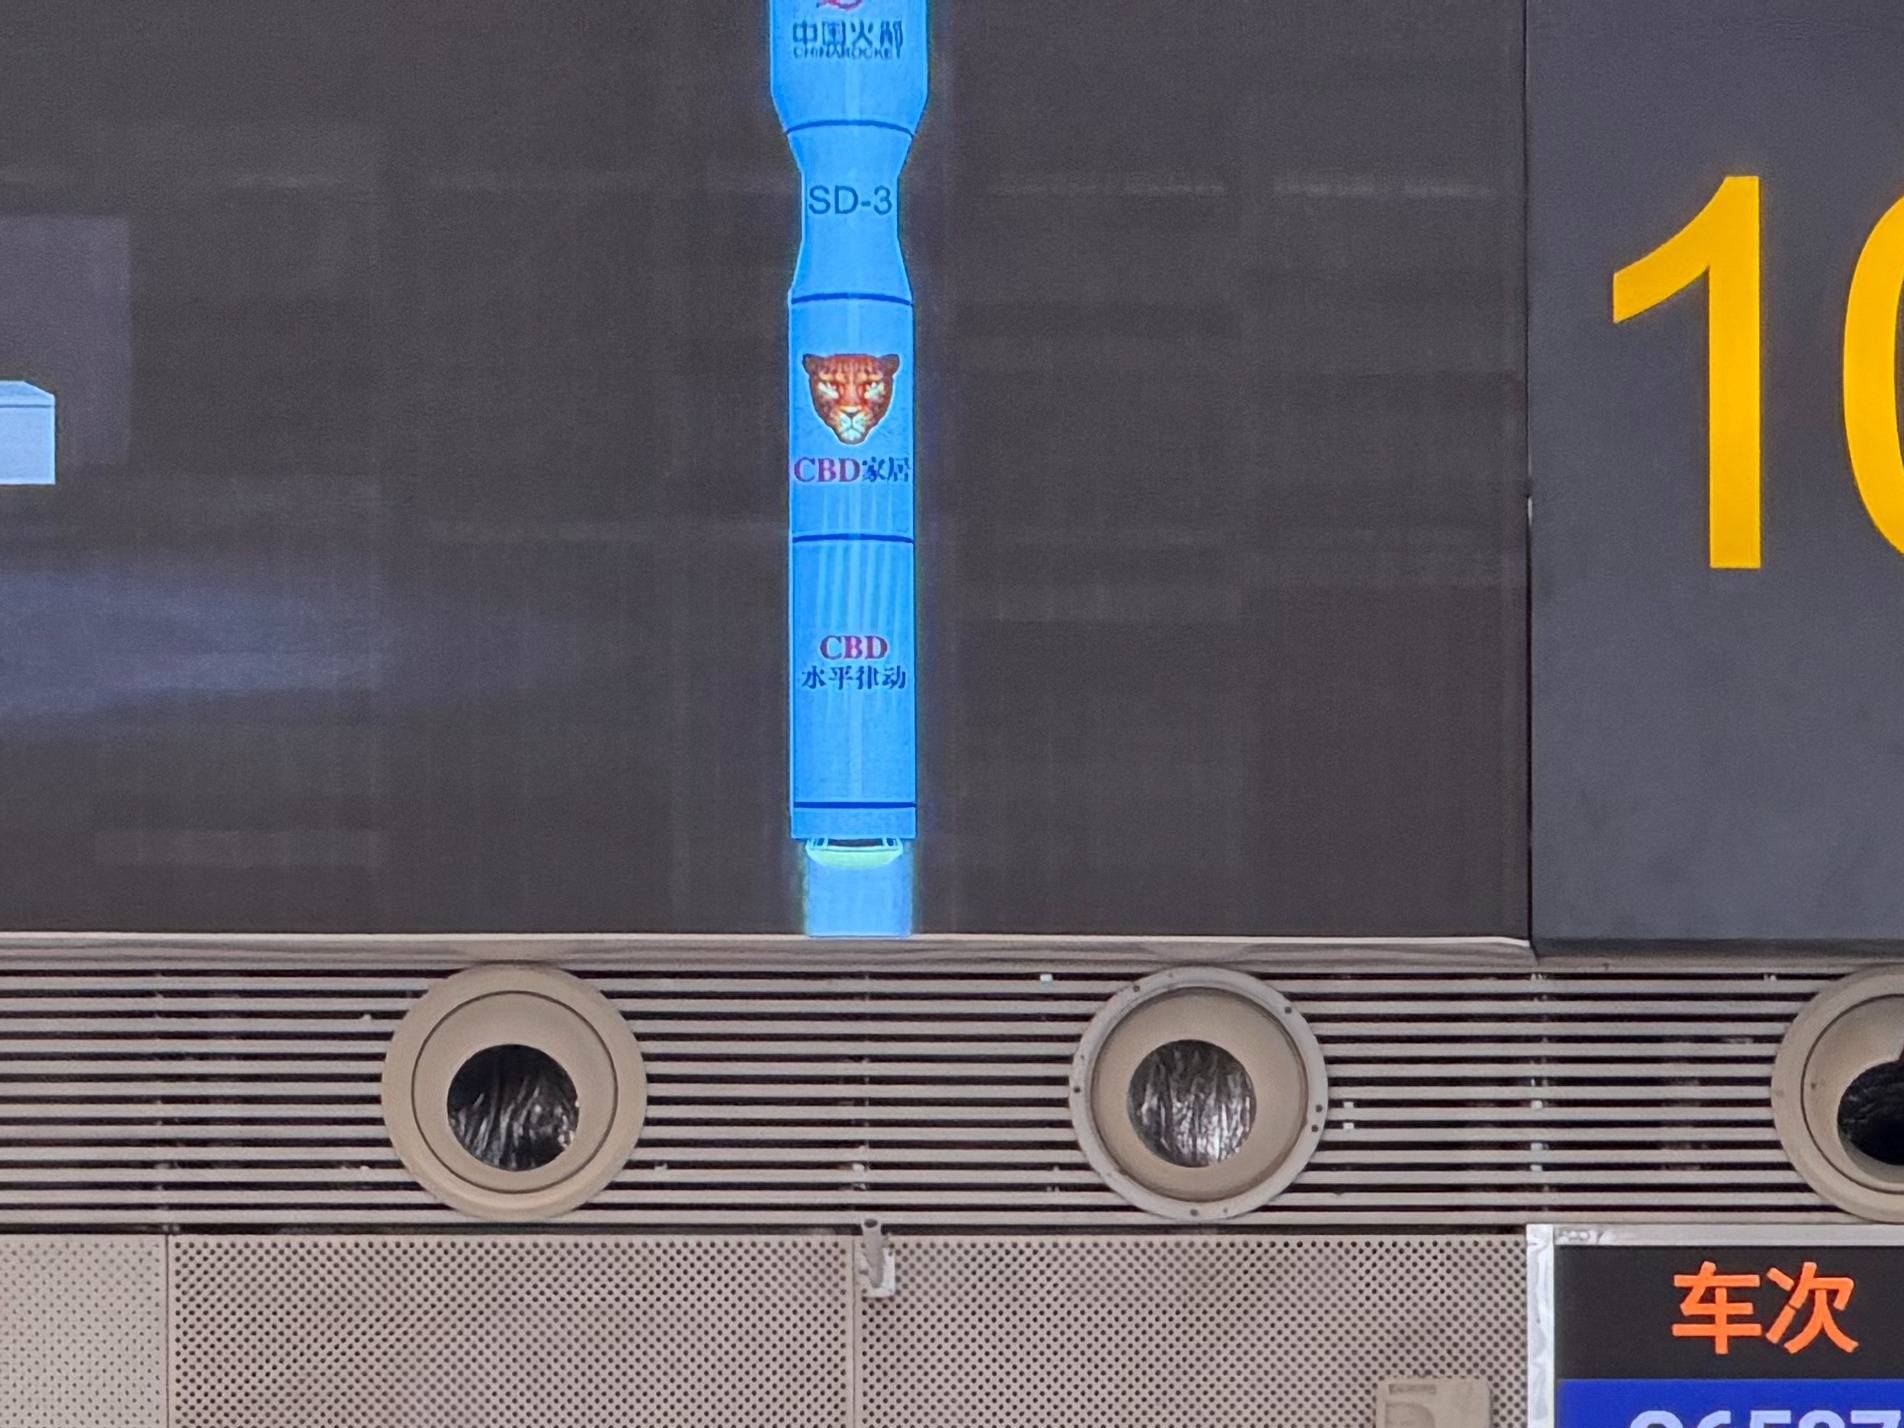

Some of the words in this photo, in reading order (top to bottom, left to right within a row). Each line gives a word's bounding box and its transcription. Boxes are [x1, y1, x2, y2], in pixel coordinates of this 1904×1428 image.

[808, 185, 892, 215] SD-3
[793, 456, 910, 483] CBD家居
[819, 635, 888, 660] CBD
[801, 664, 906, 690] 水平律动
[1672, 1261, 1858, 1354] 车次
